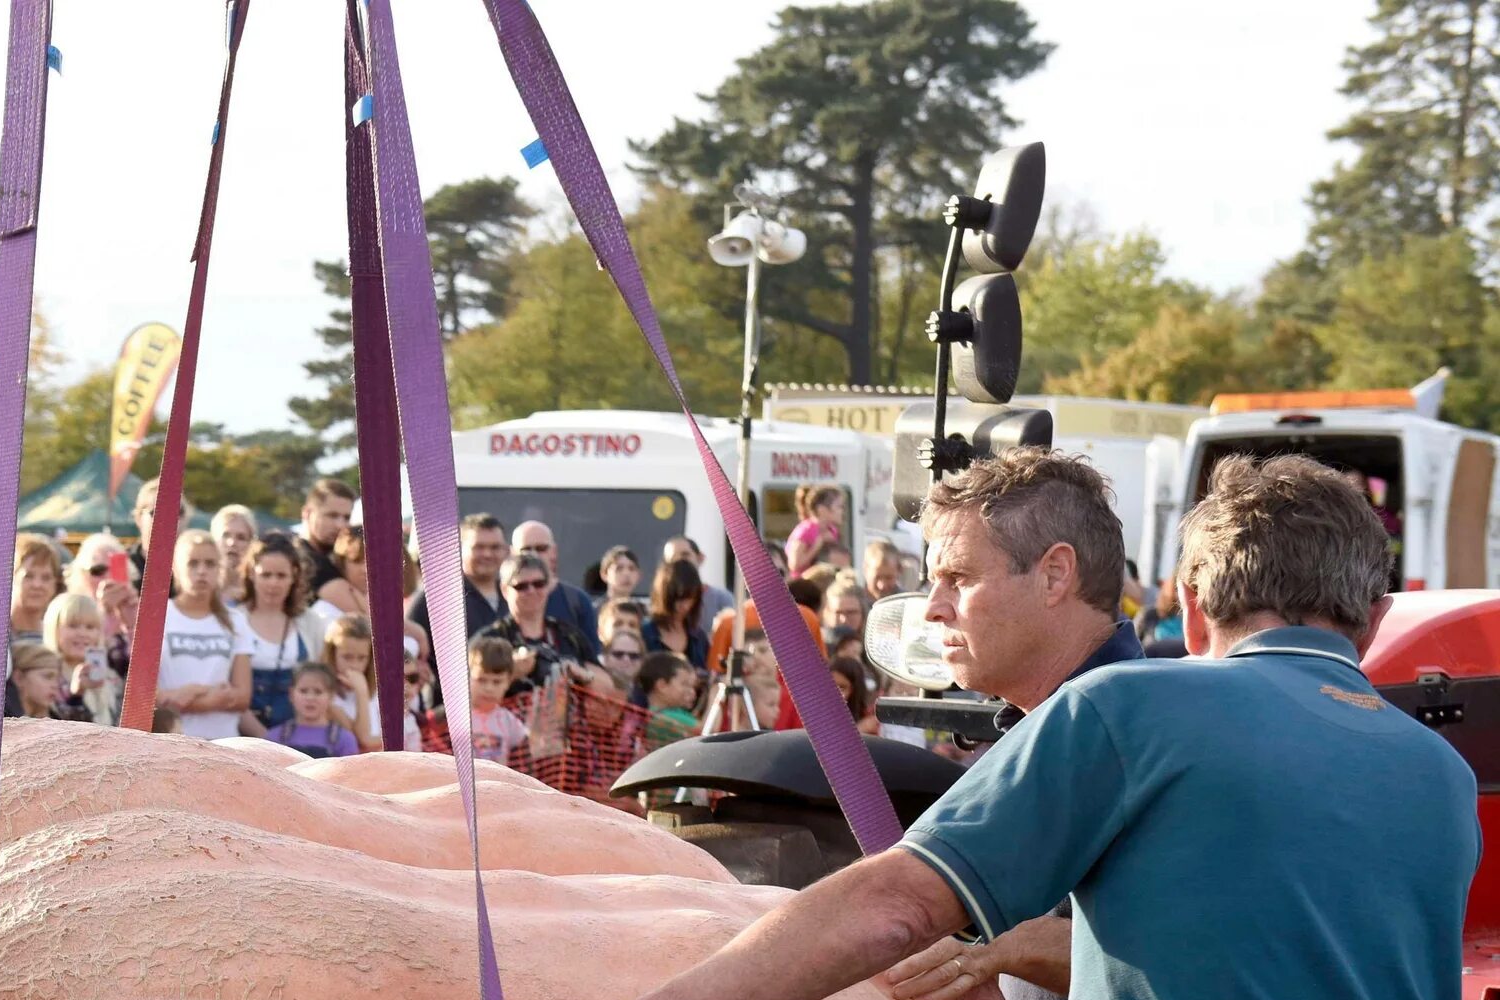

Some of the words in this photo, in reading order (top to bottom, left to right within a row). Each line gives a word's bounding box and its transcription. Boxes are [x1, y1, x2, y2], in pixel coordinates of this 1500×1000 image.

[118, 336, 165, 435] COFFEE
[826, 406, 889, 432] HOT
[489, 433, 642, 456] DAGOSTINO
